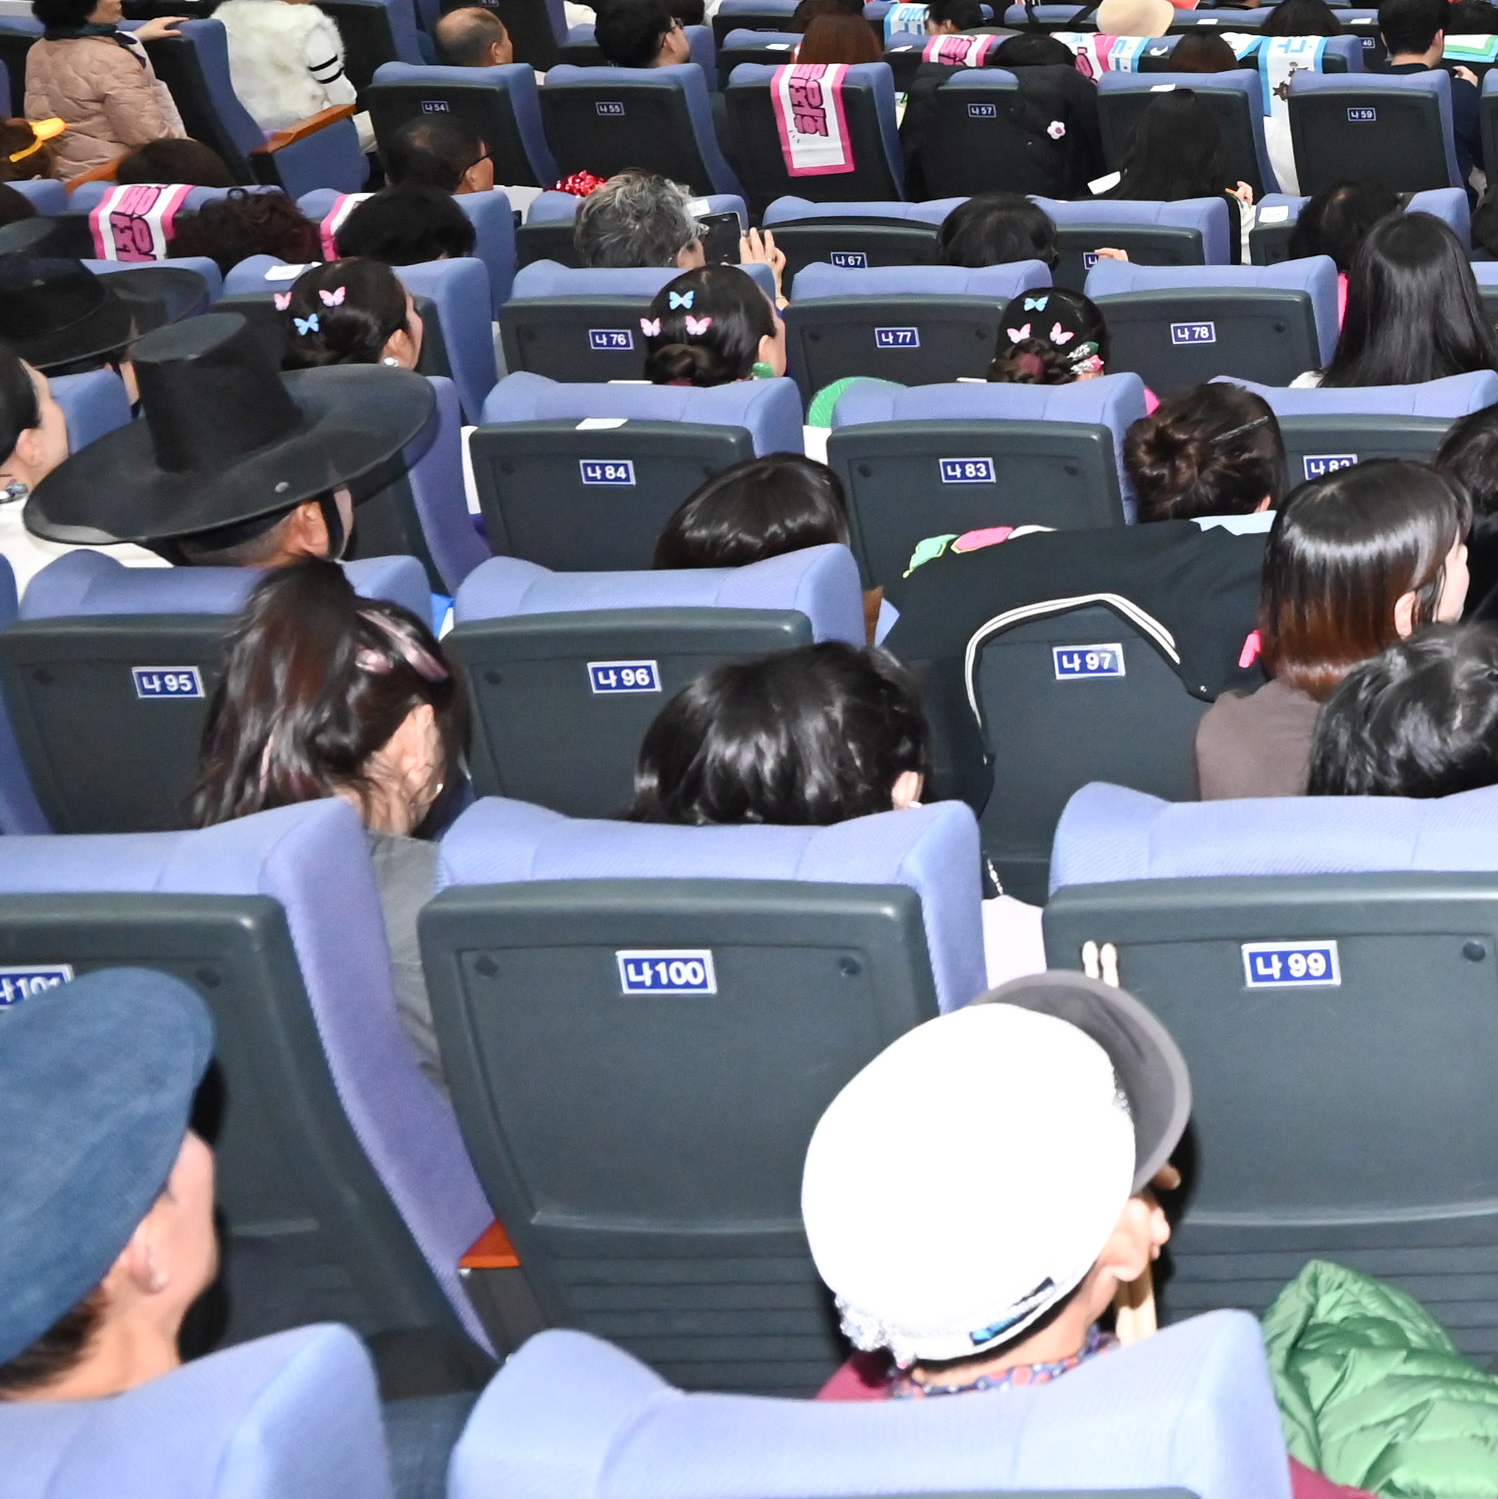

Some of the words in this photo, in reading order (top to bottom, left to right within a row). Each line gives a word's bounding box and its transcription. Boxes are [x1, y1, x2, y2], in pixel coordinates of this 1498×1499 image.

[847, 255, 863, 267] 67
[610, 332, 627, 345] 76
[896, 331, 912, 343] 77
[1192, 326, 1209, 339] 78
[586, 465, 601, 480] 나
[605, 464, 627, 479] 84
[946, 464, 961, 478] 나
[964, 462, 987, 477] 83
[1085, 652, 1112, 670] 97
[141, 674, 162, 693] 나
[164, 673, 193, 691] 95
[596, 669, 618, 688] 나
[621, 668, 651, 686] 96
[1287, 952, 1328, 977] 99
